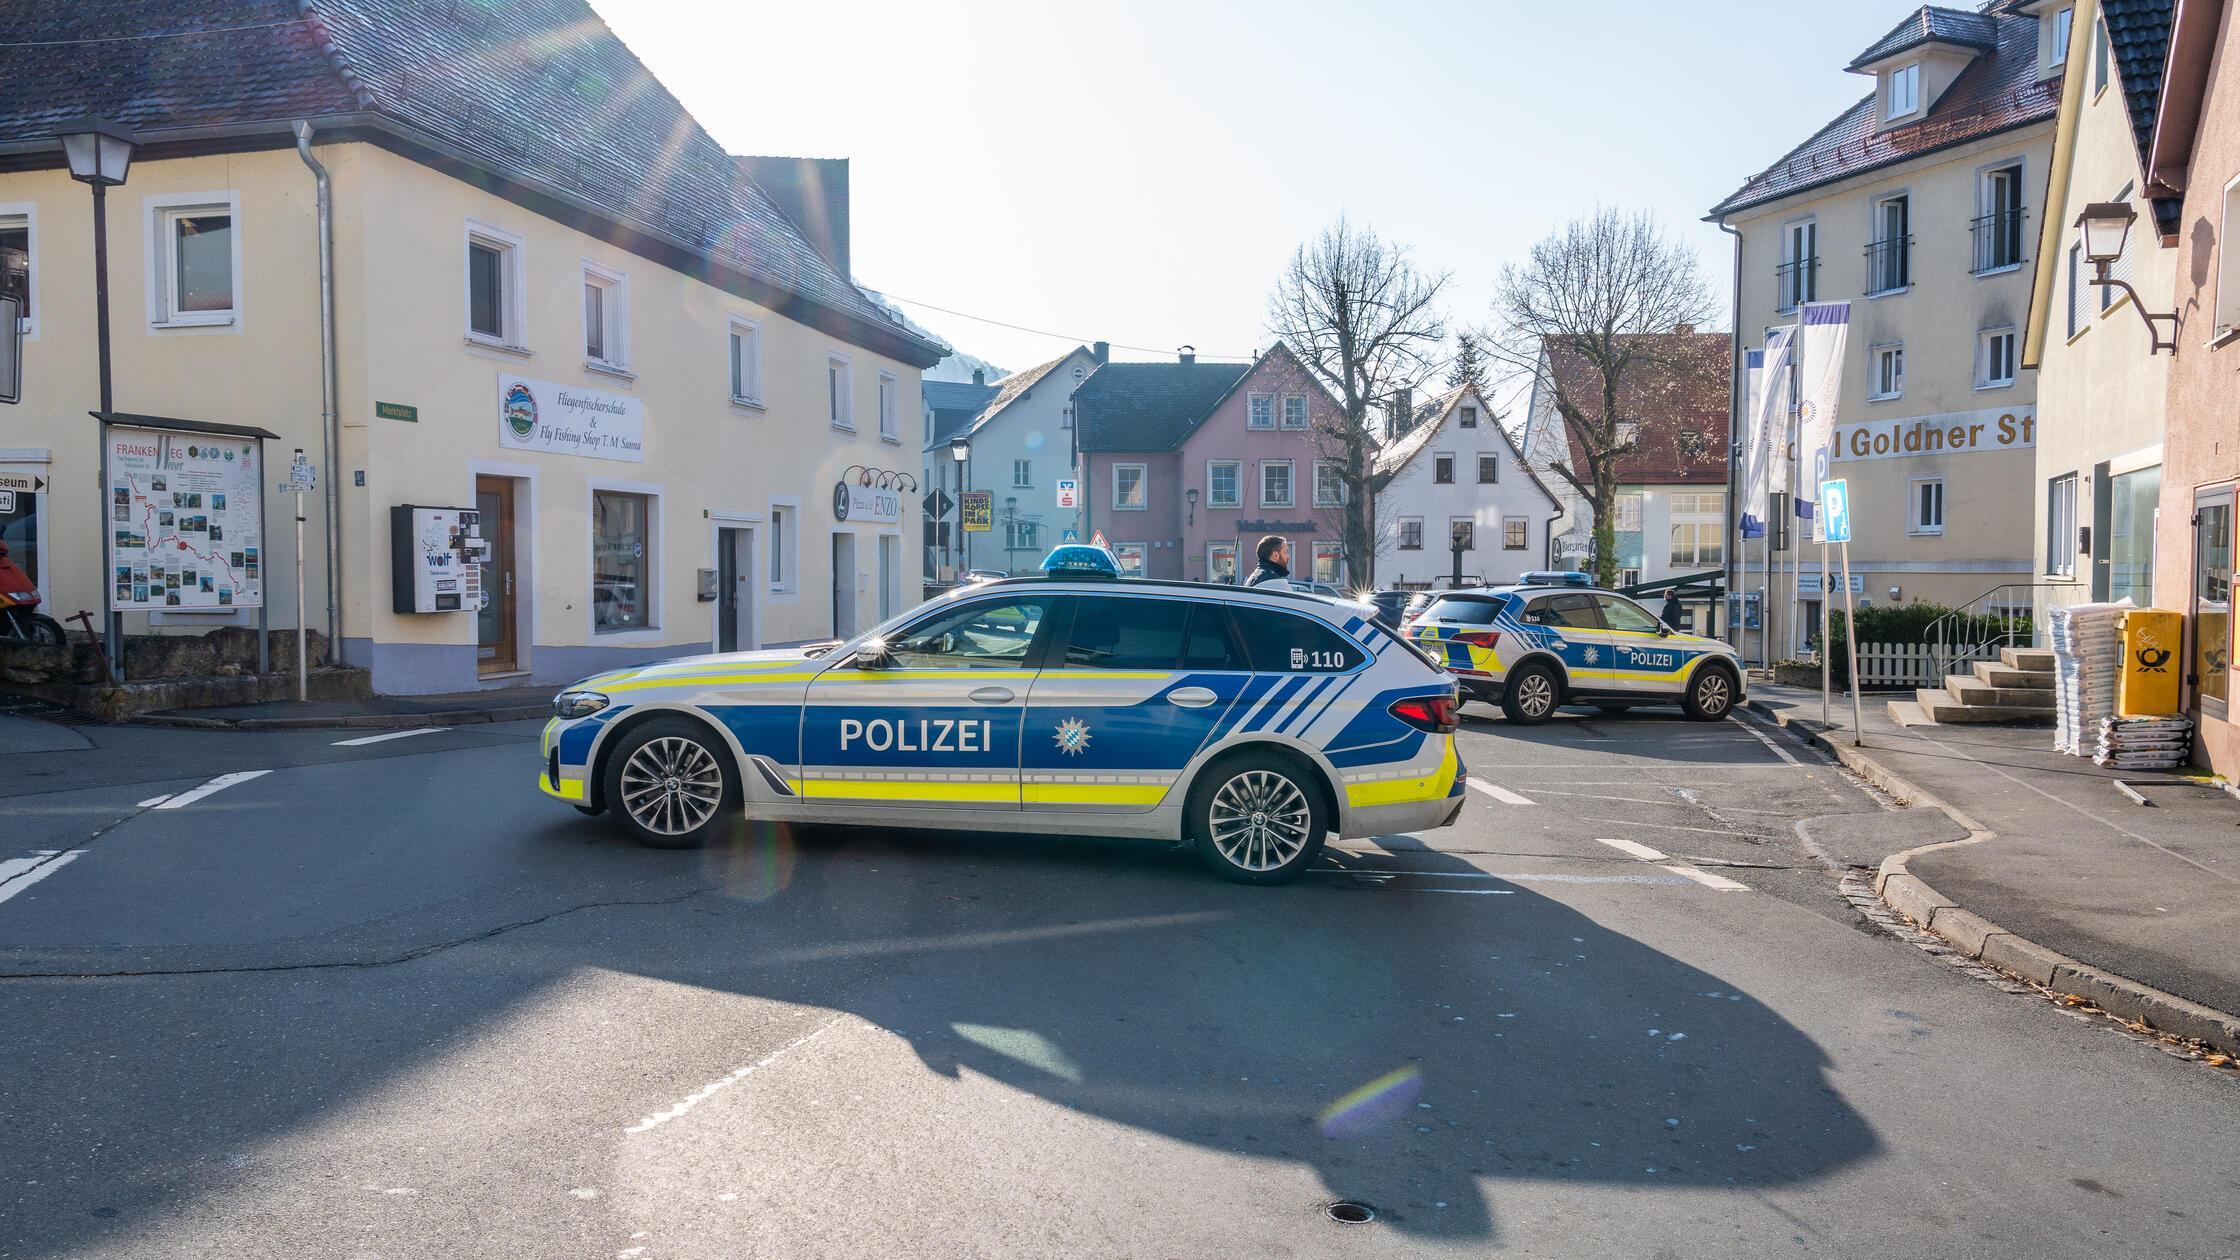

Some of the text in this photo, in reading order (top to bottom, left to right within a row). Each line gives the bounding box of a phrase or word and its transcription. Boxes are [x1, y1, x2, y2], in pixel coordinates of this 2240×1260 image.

[557, 392, 626, 415] Fliegenfischerschule
[589, 416, 597, 428] &
[540, 425, 553, 445] Fly
[554, 427, 581, 449] Fishing
[582, 431, 601, 450] Shop
[1851, 422, 1985, 457] Goldner
[875, 495, 898, 517] ENZO
[1826, 488, 1843, 535] P
[427, 552, 452, 567] wolf
[1311, 651, 1345, 668] 110
[1630, 652, 1673, 667] POLIZEI
[840, 719, 991, 752] POLIZEI
